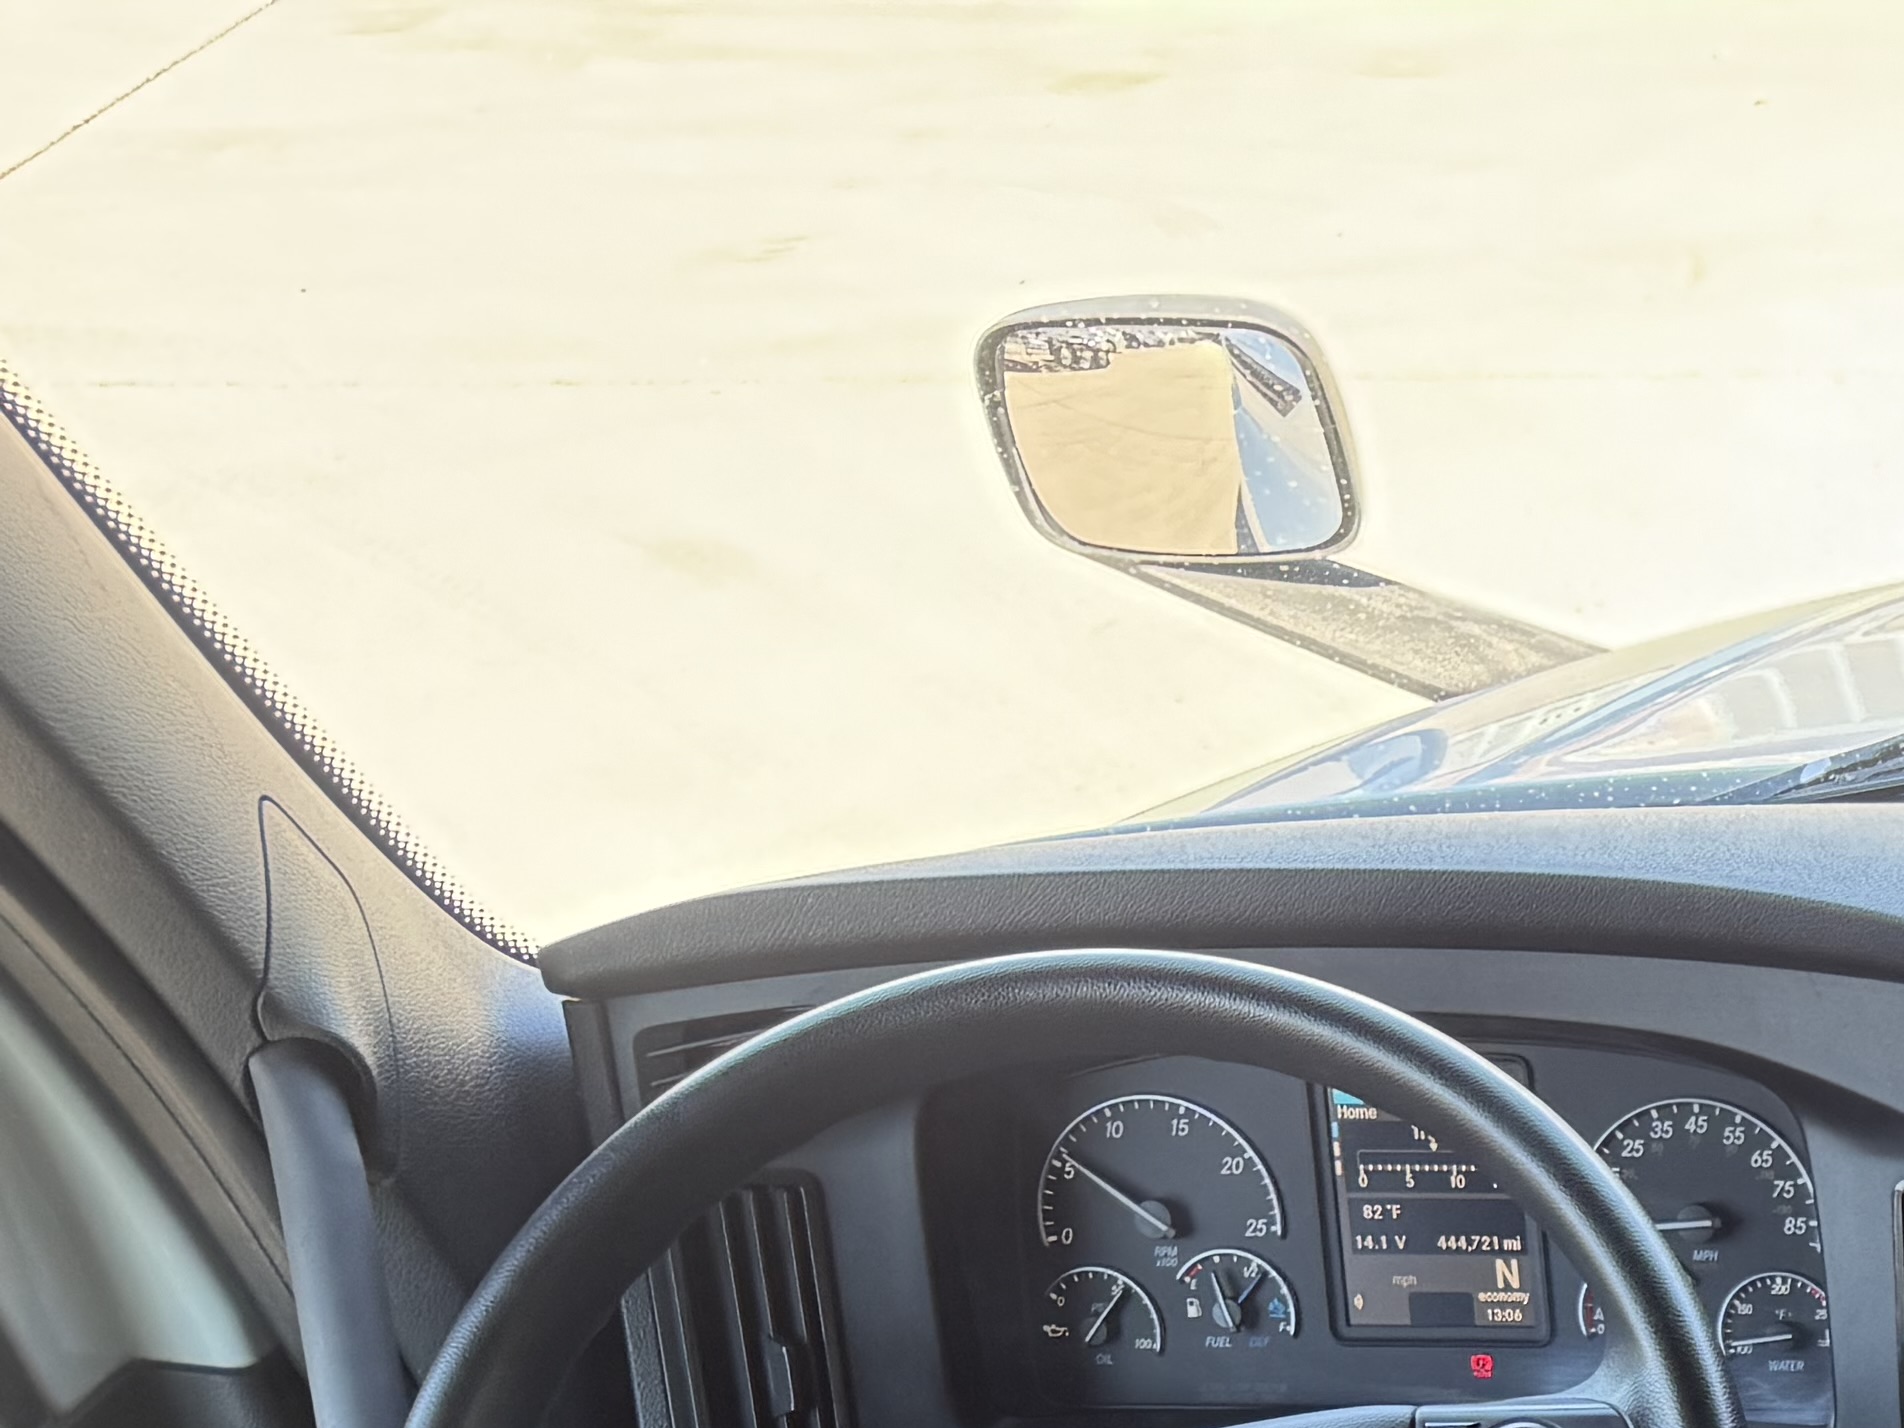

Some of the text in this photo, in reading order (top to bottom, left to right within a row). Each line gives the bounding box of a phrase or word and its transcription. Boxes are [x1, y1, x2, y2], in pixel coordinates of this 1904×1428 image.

[1337, 1105, 1378, 1120] Home
[1106, 1121, 1124, 1138] 10
[1171, 1119, 1189, 1136] 15
[1650, 1121, 1673, 1139] 35
[1685, 1116, 1708, 1134] 45
[1723, 1127, 1745, 1145] 55
[1621, 1139, 1644, 1158] 25
[1221, 1157, 1244, 1174] 20
[1750, 1150, 1772, 1168] 65
[1064, 1163, 1075, 1179] 5
[1772, 1180, 1795, 1199] 75
[1363, 1205, 1383, 1220] 82
[1245, 1220, 1267, 1237] 25
[1784, 1217, 1807, 1235] 85
[1061, 1228, 1073, 1244] 0
[1355, 1235, 1407, 1250] 14.1 V
[1437, 1235, 1522, 1252] 444,721 mi
[1693, 1251, 1718, 1261] MPH
[1392, 1274, 1417, 1287] mph
[1495, 1259, 1520, 1289] N
[1487, 1309, 1522, 1322] 13:06
[1205, 1336, 1232, 1347] FUEL
[1769, 1360, 1805, 1372] WATER
